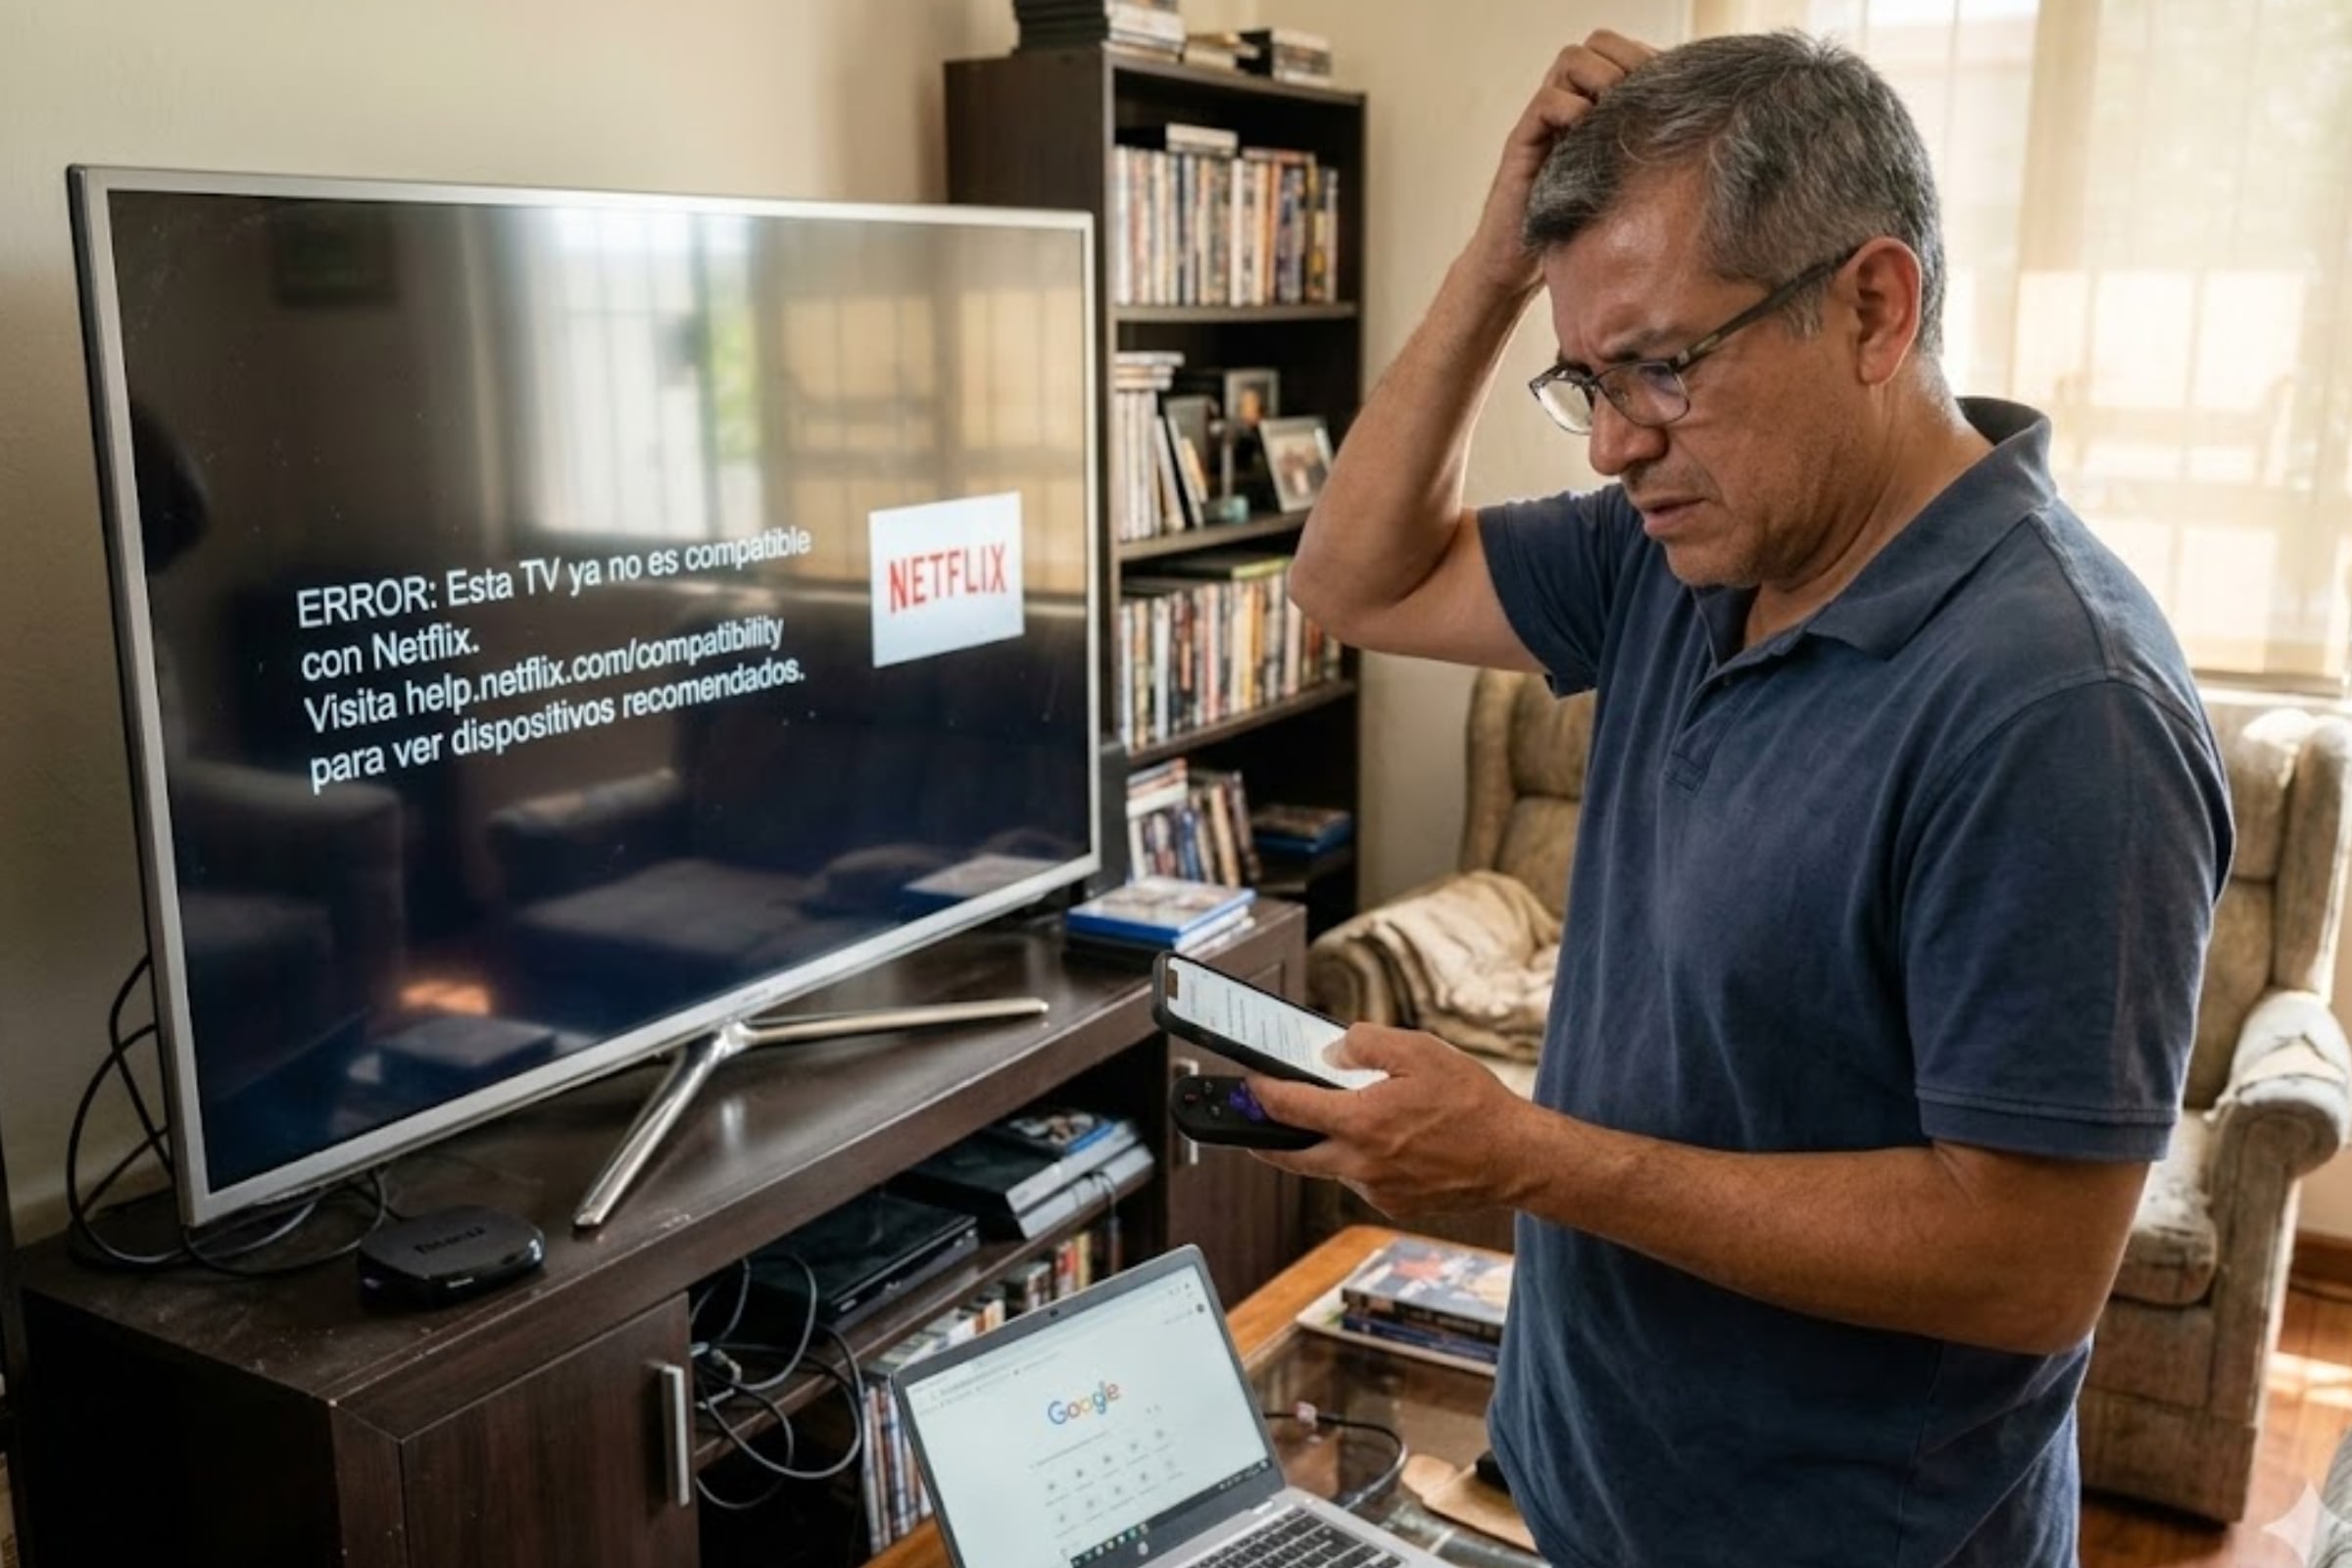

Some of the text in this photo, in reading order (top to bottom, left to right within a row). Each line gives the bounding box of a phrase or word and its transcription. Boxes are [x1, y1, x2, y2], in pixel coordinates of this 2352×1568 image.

[297, 525, 812, 628] ERROR: Esta TV ya no es compatible
[888, 541, 1006, 613] NETFLIX
[301, 621, 480, 681] con Netflix.
[304, 614, 784, 733] Visita help.netflix.com/compatibility
[311, 658, 806, 796] para ver dispositivos recomendados.
[1047, 1380, 1121, 1425] Google
